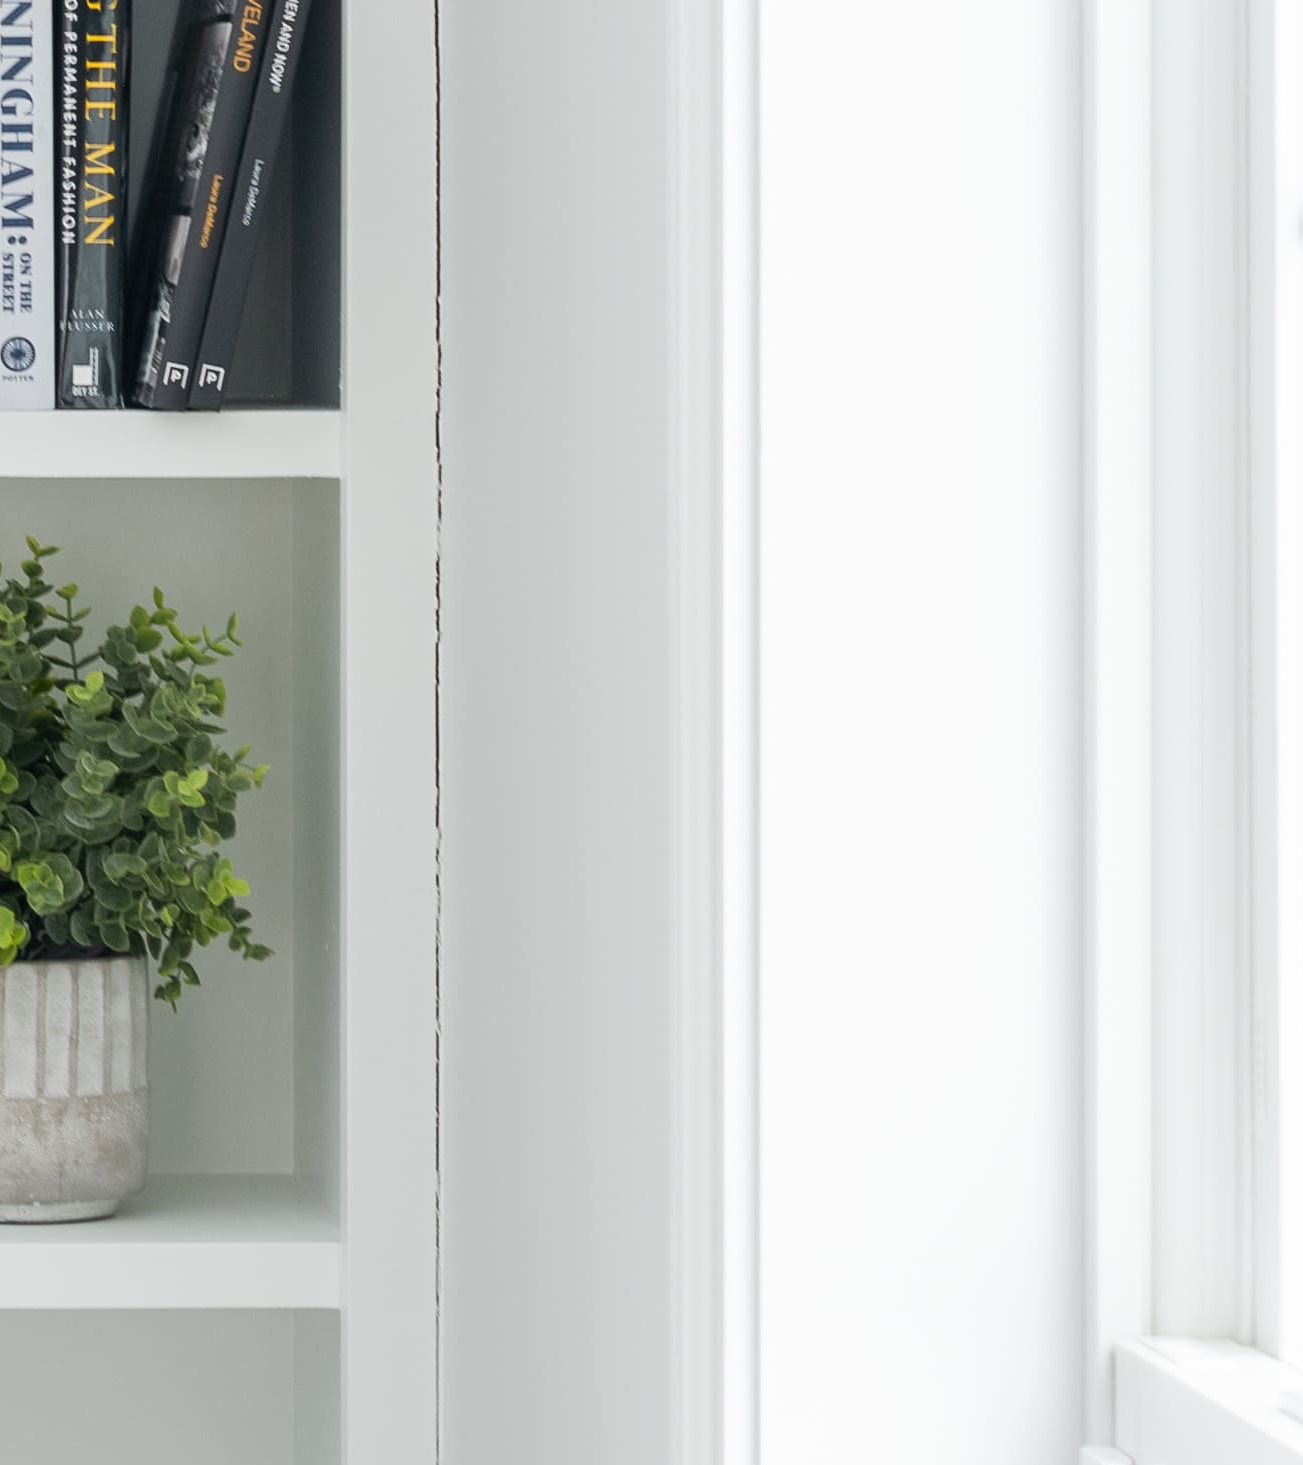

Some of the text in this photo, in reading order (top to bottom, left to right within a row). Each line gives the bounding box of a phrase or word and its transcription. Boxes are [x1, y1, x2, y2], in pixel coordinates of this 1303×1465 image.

[275, 22, 296, 54] AND
[62, 31, 78, 148] PERMANENT
[85, 23, 118, 121] THE
[61, 156, 77, 244] FASHION
[84, 141, 116, 247] MAN
[208, 173, 225, 204] Laura
[250, 158, 266, 186] Laura
[2, 252, 14, 313] STREET
[20, 252, 32, 313] ON THE
